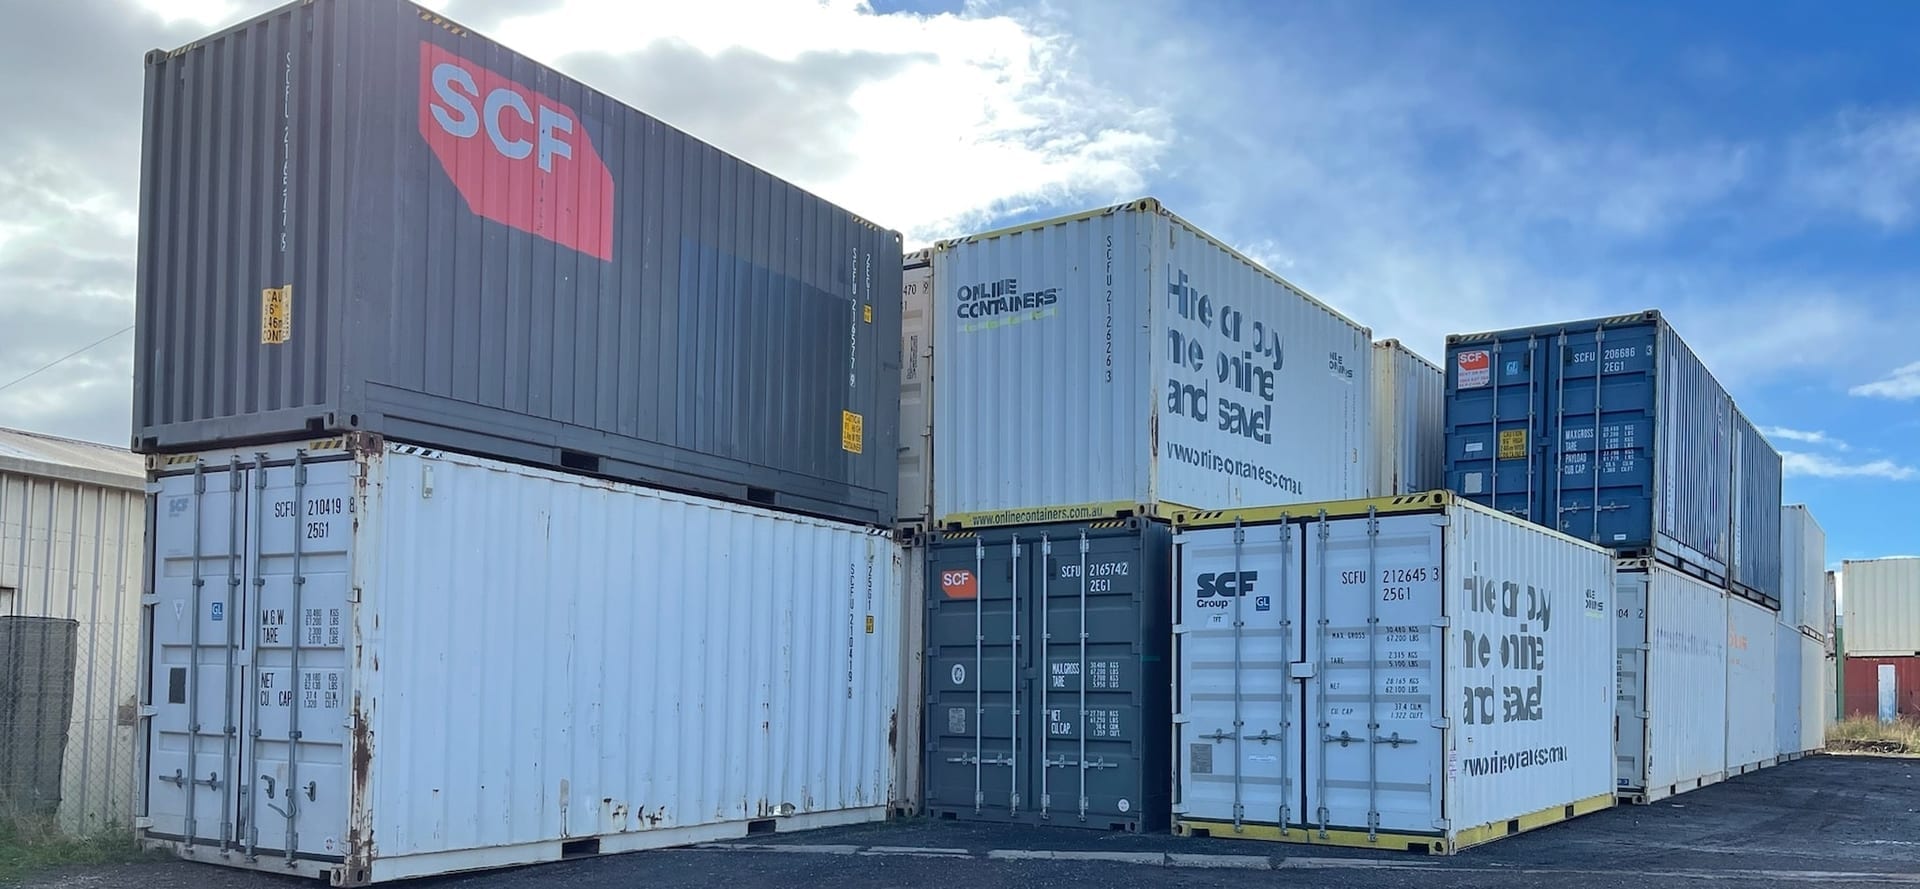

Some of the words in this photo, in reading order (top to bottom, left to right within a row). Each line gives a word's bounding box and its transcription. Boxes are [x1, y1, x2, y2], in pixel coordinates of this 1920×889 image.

[430, 63, 572, 173] SCF
[957, 279, 1016, 301] ONLINE
[957, 288, 1057, 318] CONTAINERS
[1168, 326, 1204, 372] me
[1574, 352, 1595, 363] SCFU
[1646, 345, 1653, 356] 3
[1460, 353, 1482, 364] SCF
[1604, 361, 1624, 372] 2EG1
[1105, 370, 1112, 383] 3
[1167, 379, 1208, 423] and
[1218, 397, 1272, 445] save!
[1565, 441, 1577, 451] TARE
[1565, 452, 1587, 464] PAYLOAD
[1575, 464, 1586, 474] CAP
[275, 502, 296, 518] SCFU
[308, 498, 341, 516] 210419
[349, 496, 355, 513] 8
[973, 507, 1103, 525] www.onlinecontainers.com.au
[307, 522, 329, 539] 25G1
[1061, 565, 1081, 578] SCFU
[1342, 570, 1366, 585] SCFU
[1383, 567, 1427, 584] 212645
[1432, 567, 1440, 581] 3
[943, 572, 969, 586] SCF
[1090, 579, 1111, 592] 2EG1
[1197, 571, 1258, 598] SCF
[1383, 586, 1411, 601] 25G1
[1197, 599, 1228, 609] Group
[1256, 597, 1269, 607] GL
[1638, 608, 1644, 619] 2
[329, 617, 340, 626] LBS
[262, 628, 279, 644] TARE
[1347, 631, 1366, 639] GROSS
[1409, 634, 1419, 642] LBS
[1499, 624, 1544, 671] onine
[1330, 657, 1345, 665] TARE
[1408, 651, 1418, 659] KGS
[1408, 660, 1419, 668] LBS
[261, 672, 275, 689] NET
[1052, 675, 1065, 688] TARE
[1330, 682, 1340, 690] NET
[1409, 677, 1419, 685] KGS
[1408, 686, 1419, 694] LBS
[1463, 675, 1495, 725] and
[1051, 709, 1061, 722] NET
[1341, 707, 1354, 715] CAP
